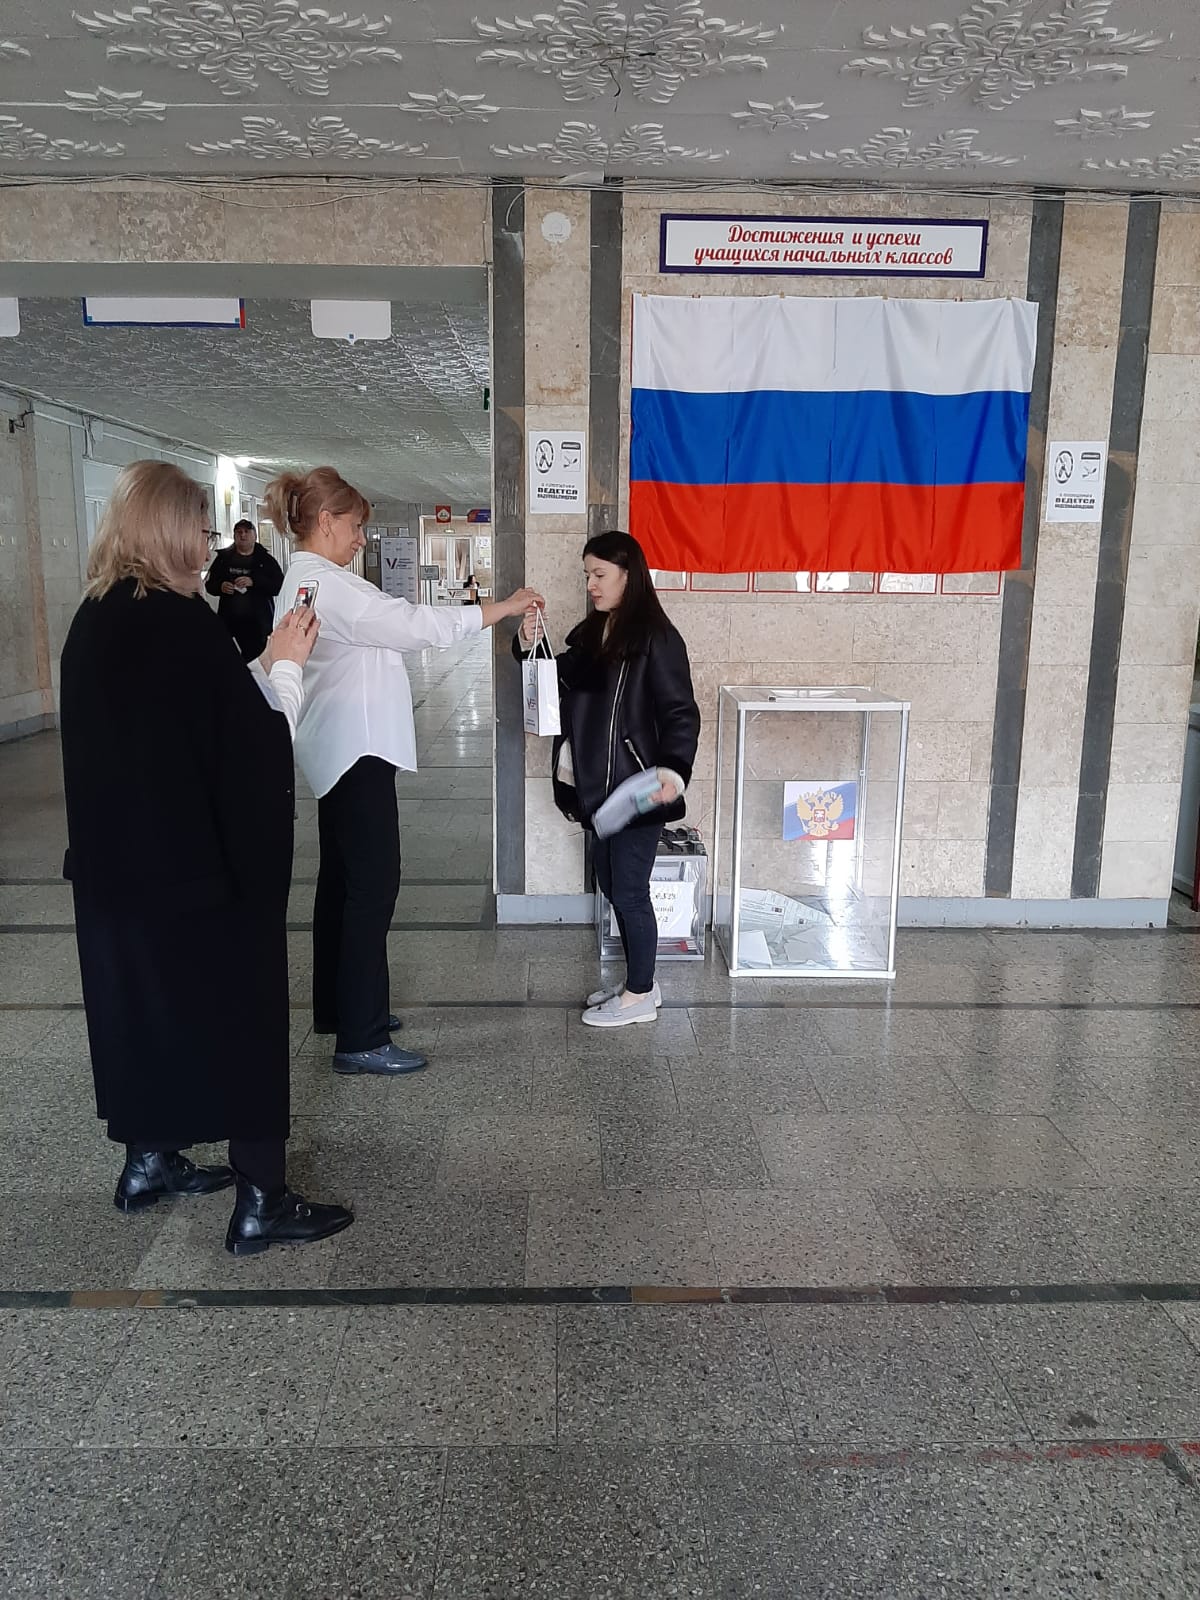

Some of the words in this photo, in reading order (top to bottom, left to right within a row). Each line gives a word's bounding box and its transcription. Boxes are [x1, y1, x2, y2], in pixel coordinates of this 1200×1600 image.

[728, 224, 844, 245] Достижения
[852, 231, 863, 245] и
[866, 232, 922, 251] успехи
[694, 247, 780, 266] учащихся
[783, 249, 882, 264] начальных
[885, 247, 953, 265] классов
